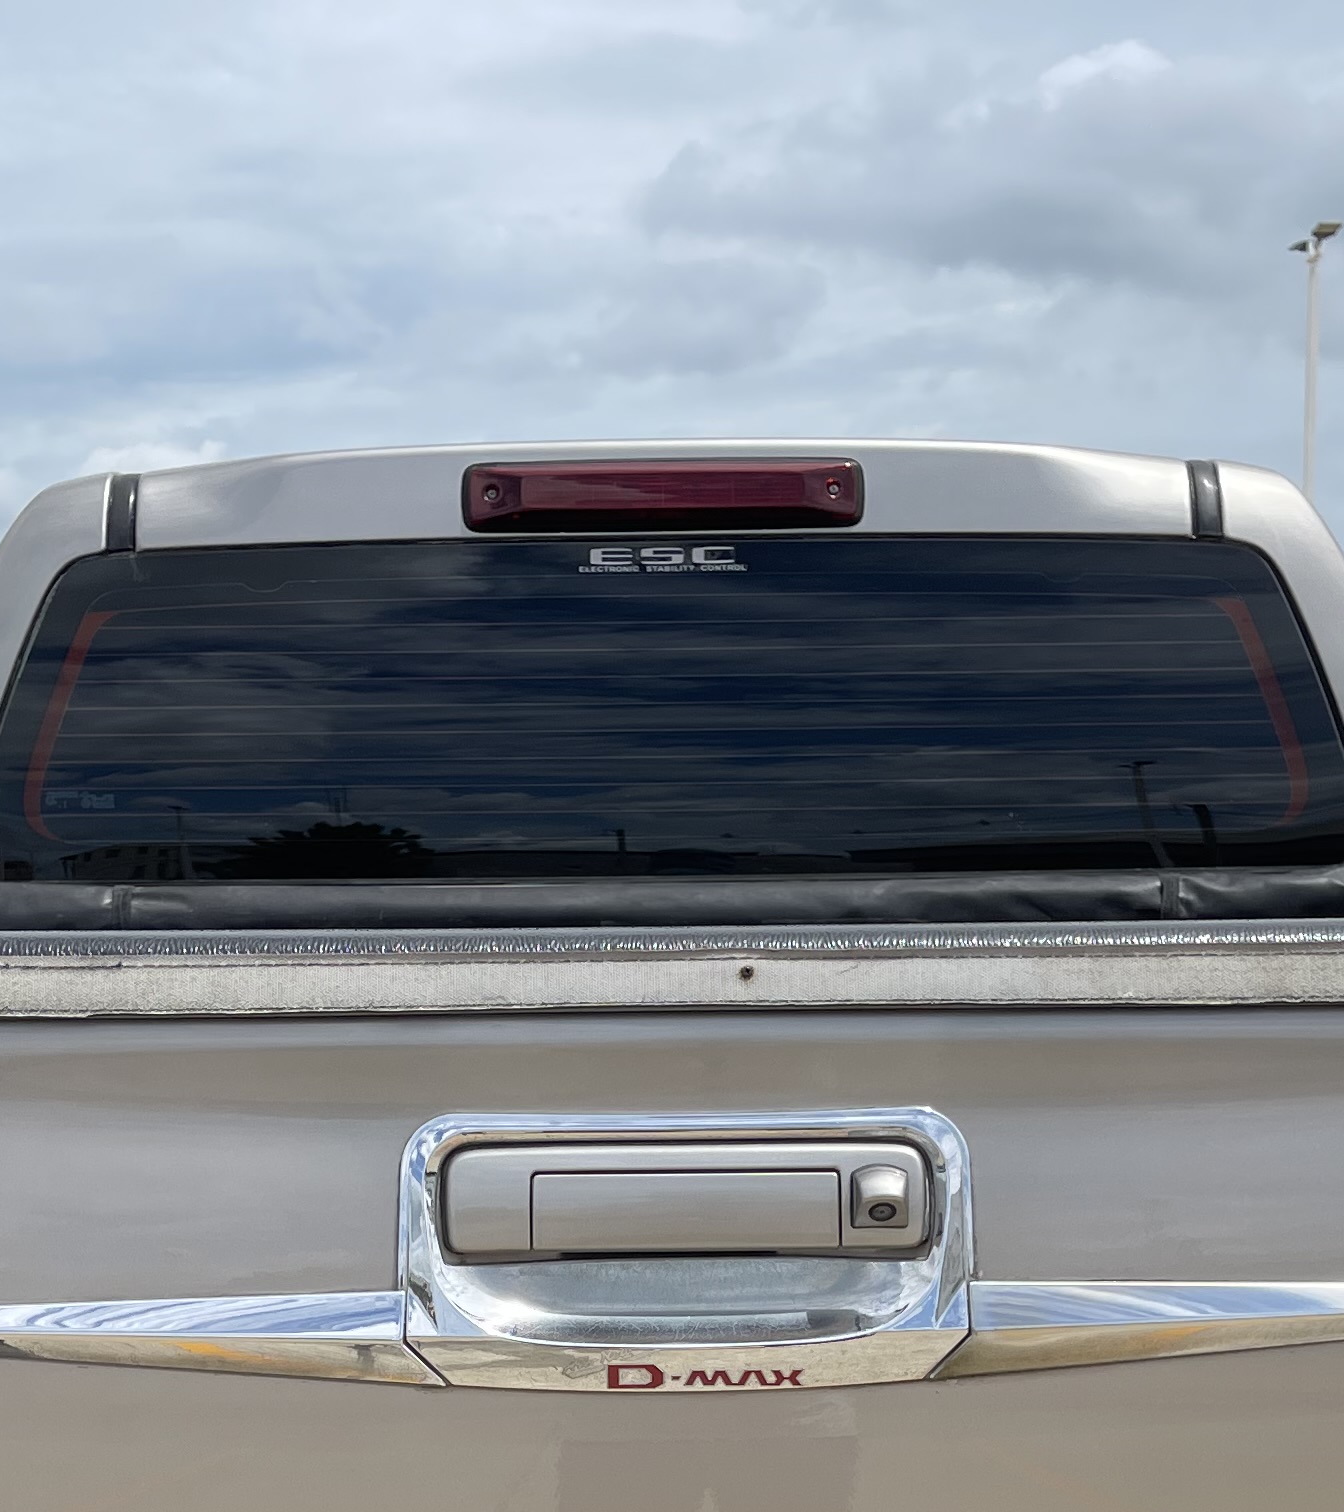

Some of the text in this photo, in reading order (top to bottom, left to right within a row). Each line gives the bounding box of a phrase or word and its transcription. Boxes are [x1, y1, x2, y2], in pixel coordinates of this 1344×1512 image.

[590, 546, 736, 565] ESC
[578, 564, 748, 573] ELECTRONIC STABILITY CONTROL
[607, 1363, 804, 1389] D-MAX
